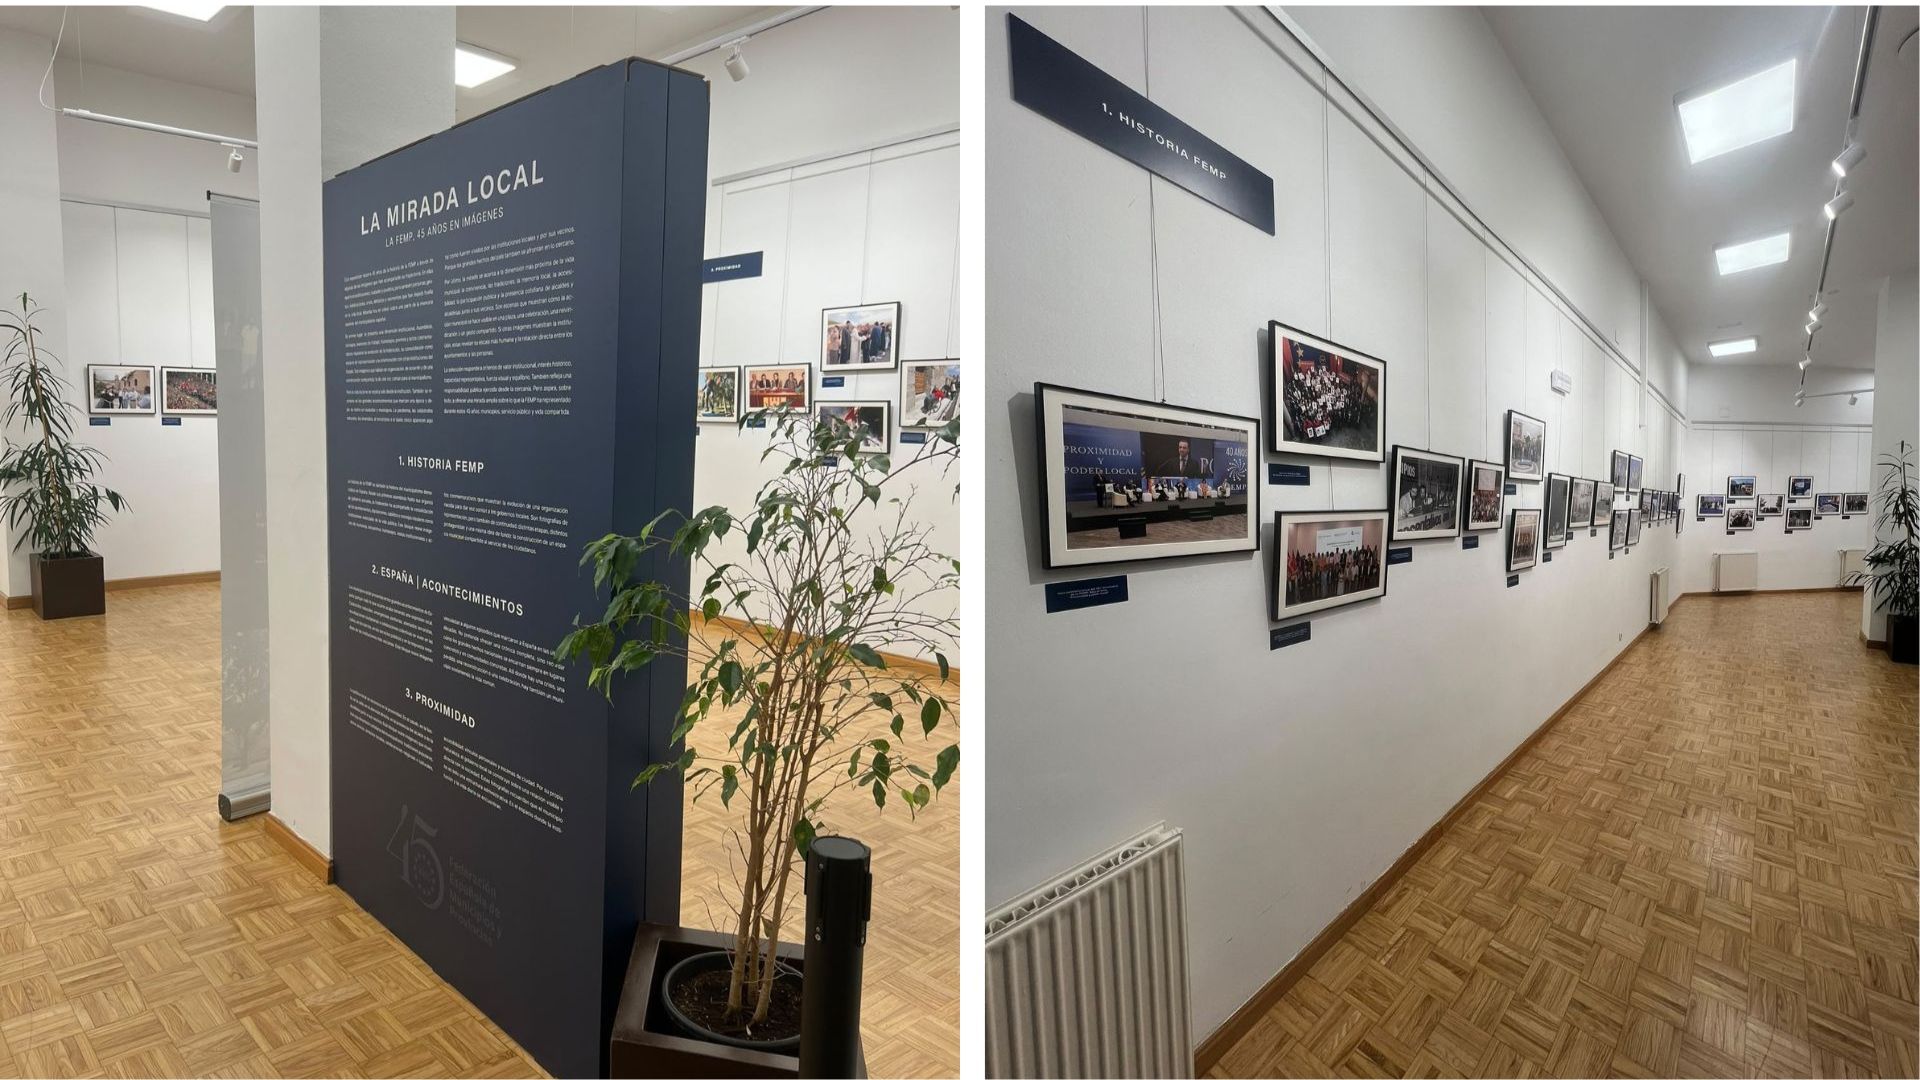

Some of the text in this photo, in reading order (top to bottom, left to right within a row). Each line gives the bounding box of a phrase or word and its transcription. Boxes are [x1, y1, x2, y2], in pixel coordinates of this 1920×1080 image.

[1102, 103, 1226, 180] 1. HISTORIA FEMP
[361, 160, 544, 236] LA MIRADA LOCAL
[386, 236, 394, 248] LA
[417, 228, 426, 238] 45
[428, 223, 448, 236] AÑOS
[450, 218, 460, 231] EN
[462, 206, 504, 228] IMÁGENES
[399, 456, 484, 473] 1. HISTORIA FEMP
[1064, 445, 1132, 457] PROXIMIDAD
[372, 564, 378, 574] 2.
[381, 566, 414, 585] ESPAÑA
[422, 578, 524, 616] ACONTECIMIENTOS
[406, 688, 476, 728] 3. PROXIMIDAD
